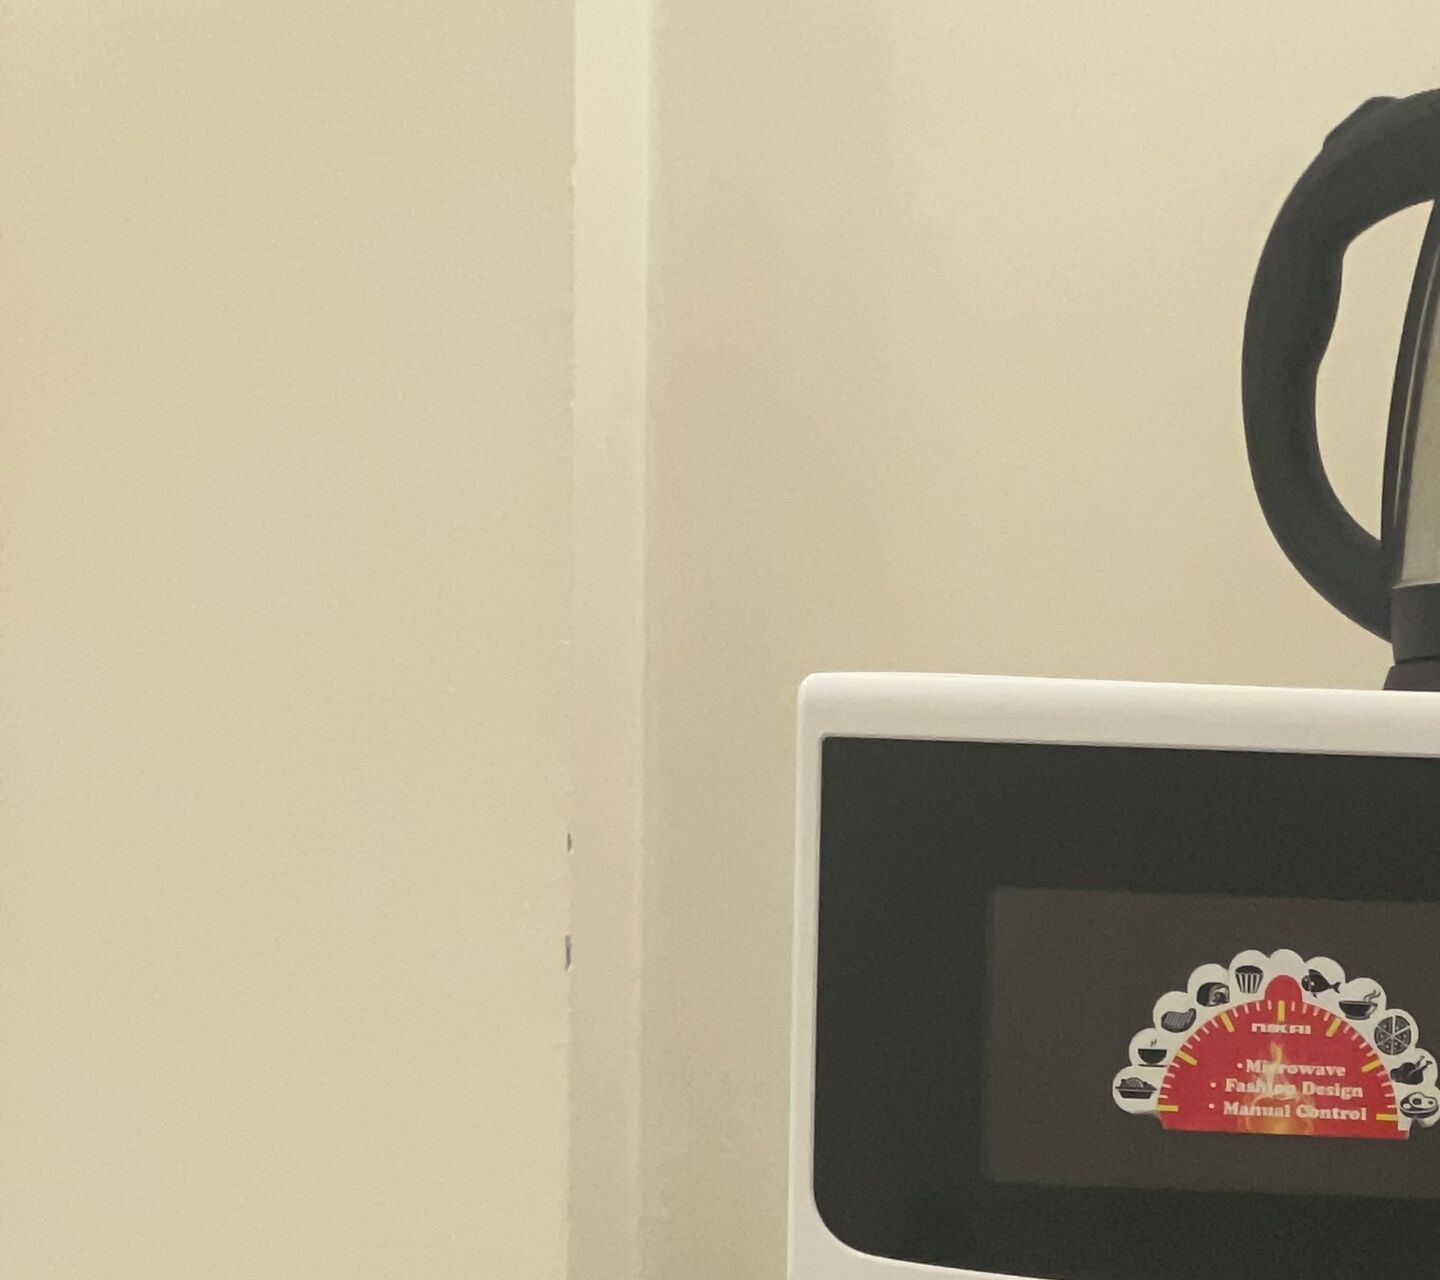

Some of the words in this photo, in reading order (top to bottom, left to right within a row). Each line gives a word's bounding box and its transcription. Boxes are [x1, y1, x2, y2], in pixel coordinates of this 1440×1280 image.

[1246, 1059, 1346, 1076] Microwave
[1302, 1081, 1364, 1100] Design
[1223, 1101, 1291, 1119] Manual
[1295, 1103, 1367, 1121] Control
